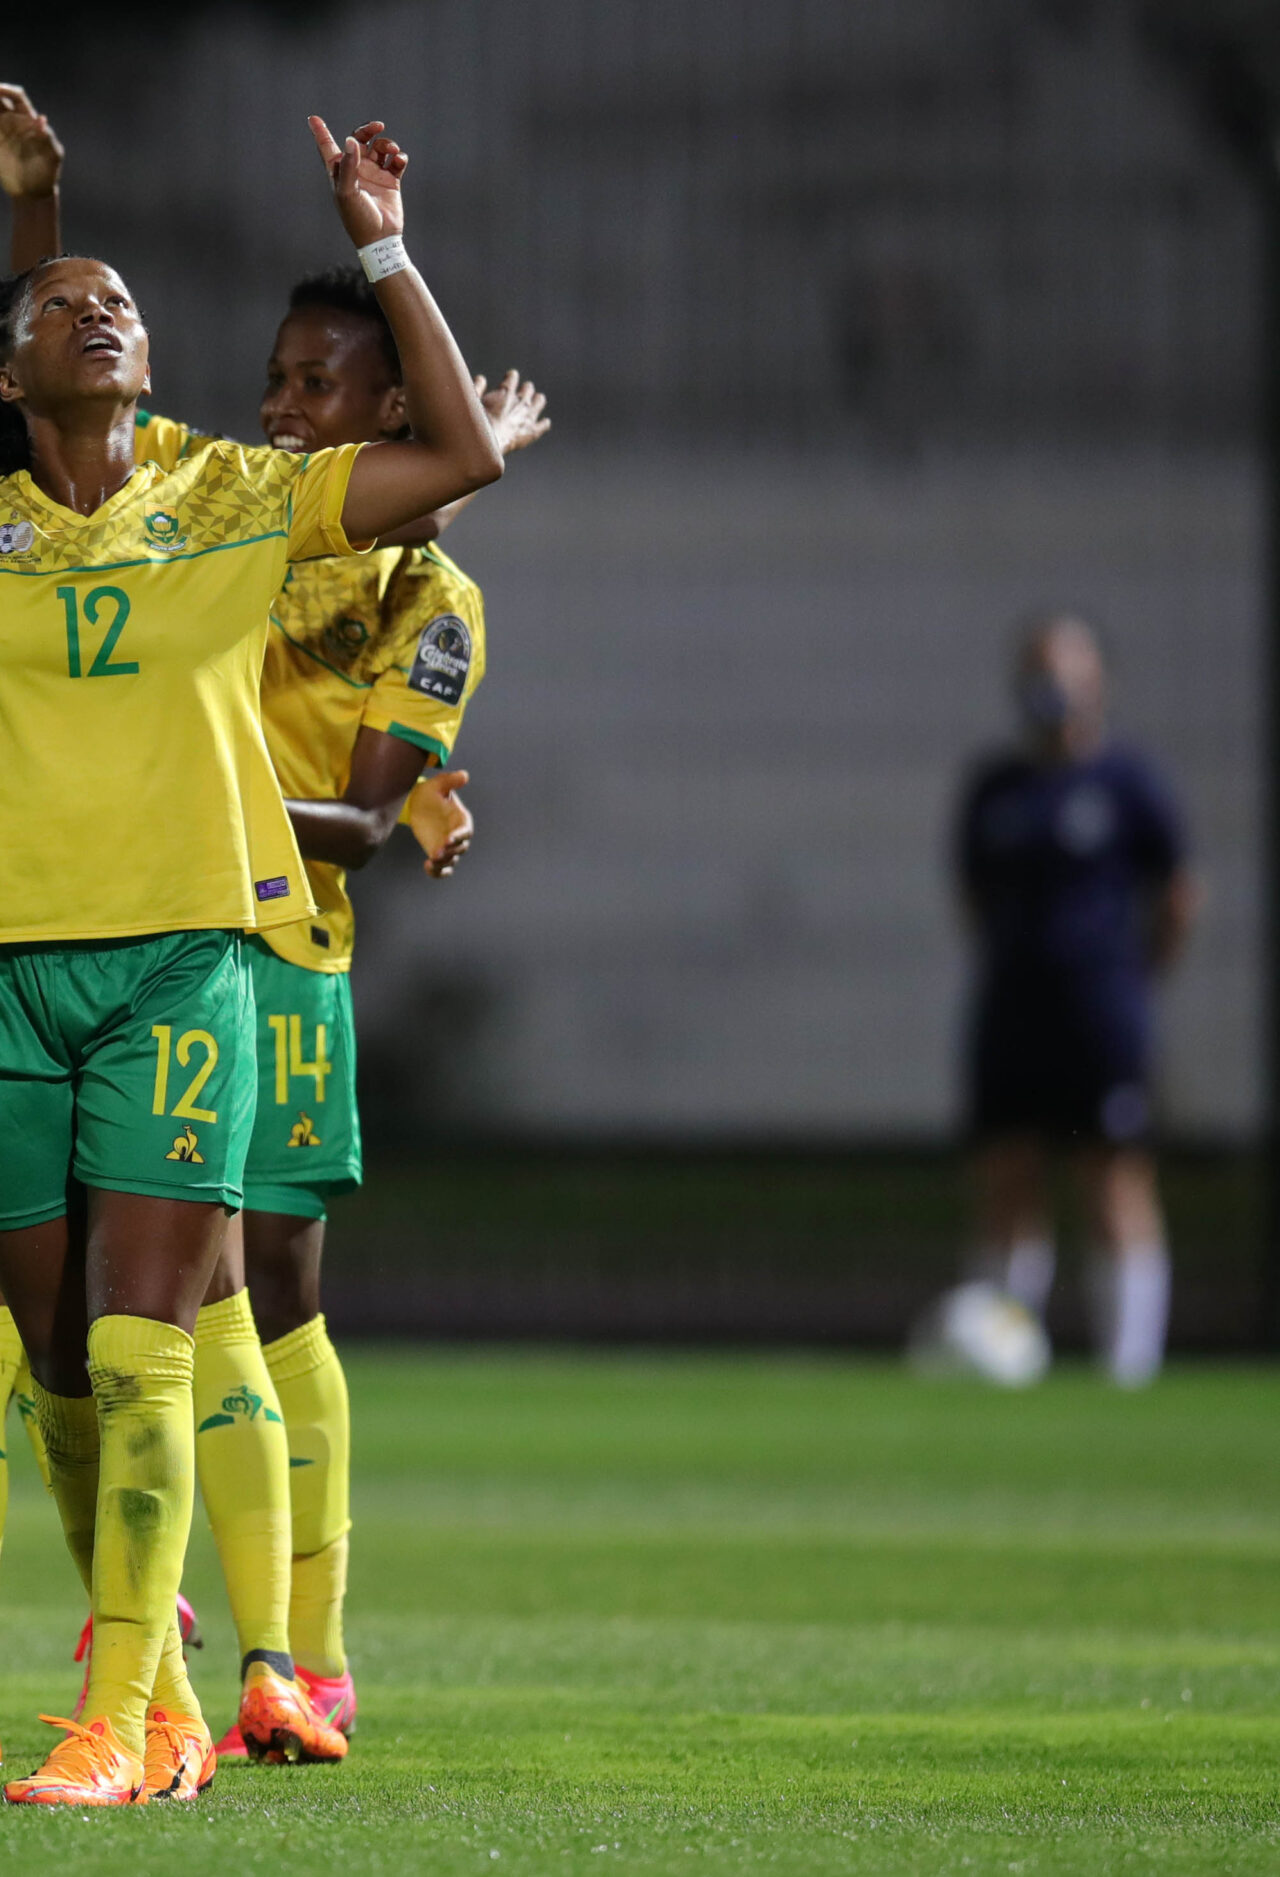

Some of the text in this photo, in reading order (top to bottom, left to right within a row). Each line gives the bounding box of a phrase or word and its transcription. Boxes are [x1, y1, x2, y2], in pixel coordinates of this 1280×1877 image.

[56, 586, 140, 678] 12
[151, 1024, 218, 1124] 12
[268, 1014, 332, 1105] 14
